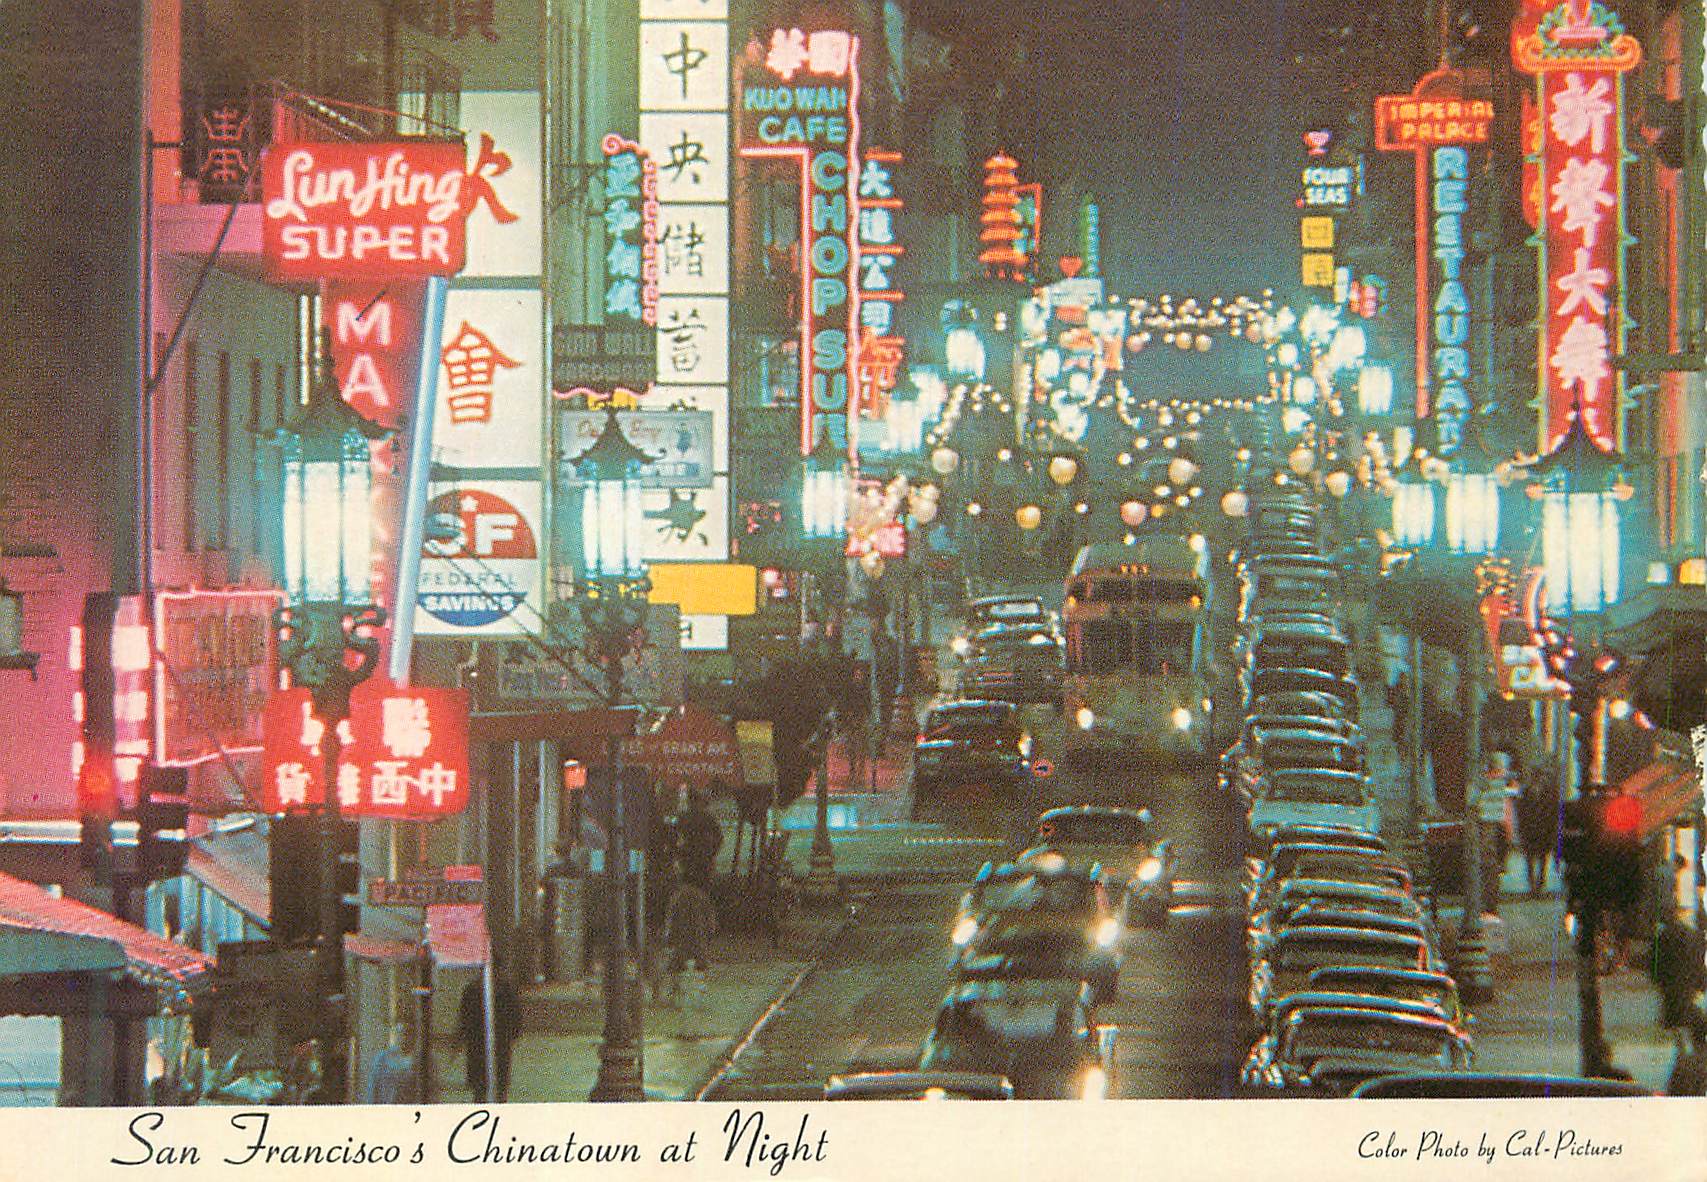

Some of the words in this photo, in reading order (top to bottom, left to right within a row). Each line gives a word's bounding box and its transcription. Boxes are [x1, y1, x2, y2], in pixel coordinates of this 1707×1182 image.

[744, 86, 793, 110] KUO
[796, 86, 847, 110] WAH
[1391, 101, 1494, 120] IMPERIAL
[758, 116, 847, 143] CAFE
[1402, 122, 1487, 140] PALACE
[1302, 166, 1350, 185] FOUR
[267, 151, 355, 222] Lun
[349, 152, 467, 223] Hing
[1305, 186, 1350, 204] SEAS
[811, 150, 848, 315] CHOP
[281, 224, 450, 264] SUPER
[425, 594, 516, 612] SAVINGS
